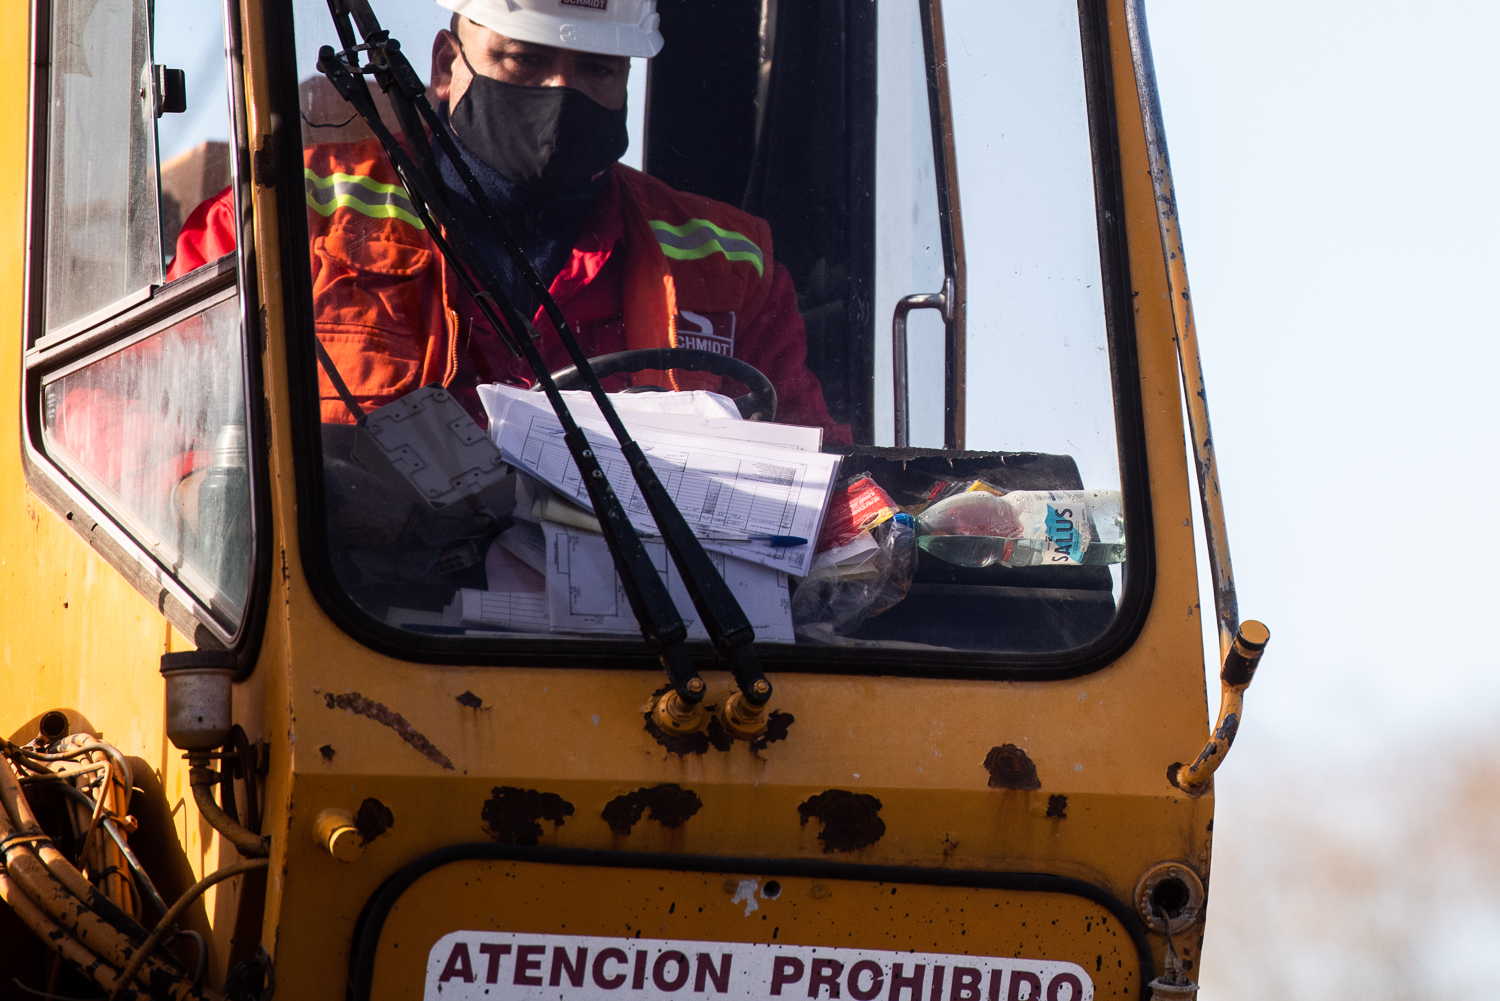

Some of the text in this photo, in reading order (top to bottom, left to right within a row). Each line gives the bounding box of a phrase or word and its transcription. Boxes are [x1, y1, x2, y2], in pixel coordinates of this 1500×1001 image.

[677, 336, 729, 356] CHMIDT
[1052, 508, 1074, 562] SALUS
[438, 942, 1083, 1001] ATENCION PROHIBIDO
